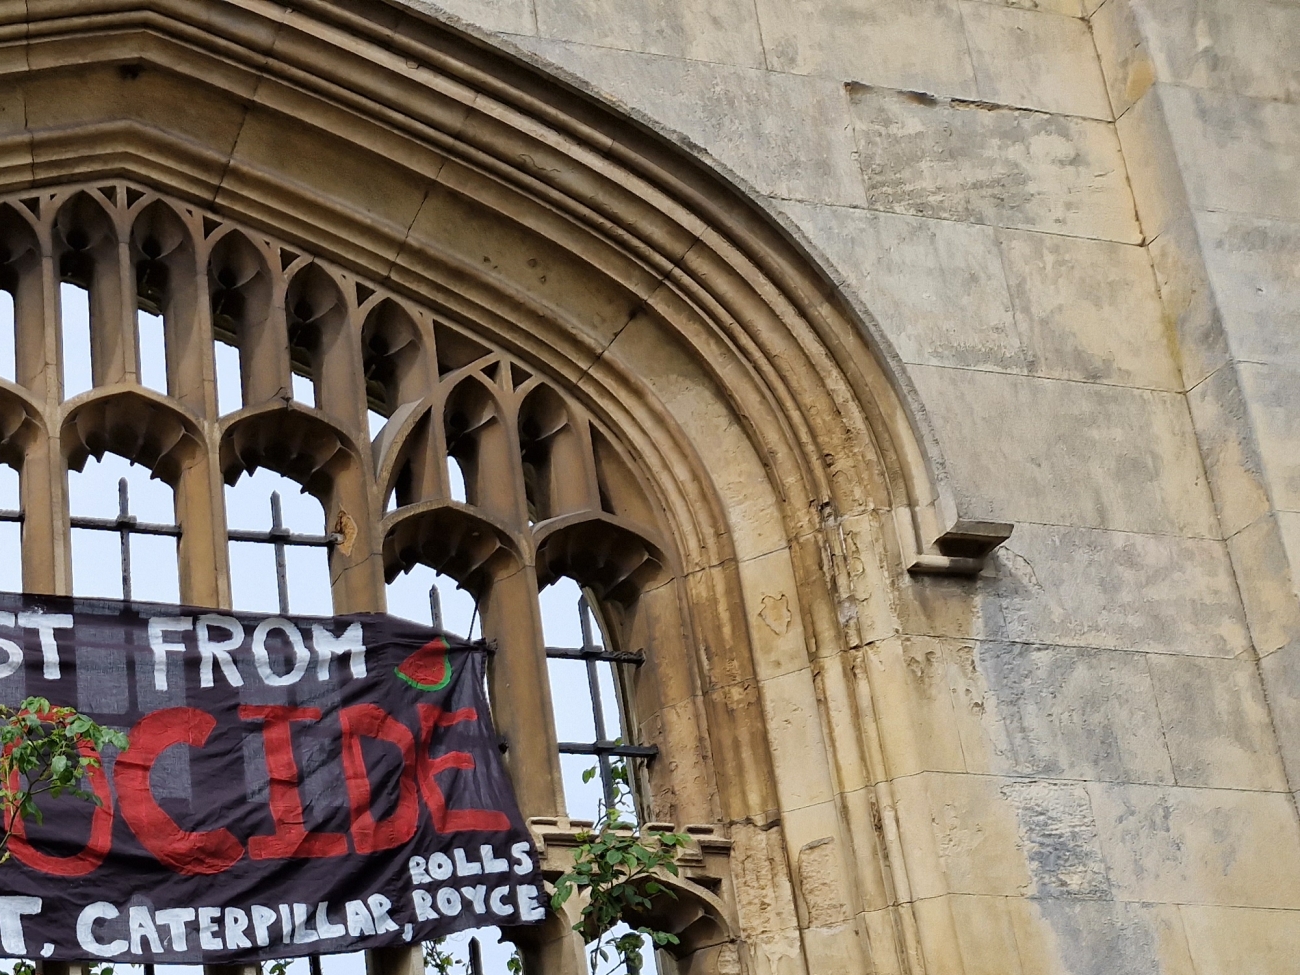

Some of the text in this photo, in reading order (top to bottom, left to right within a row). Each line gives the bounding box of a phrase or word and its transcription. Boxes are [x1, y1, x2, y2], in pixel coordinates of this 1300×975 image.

[147, 613, 368, 692] FROM
[408, 841, 534, 886] ROLLS
[412, 884, 546, 923] ROYCE
